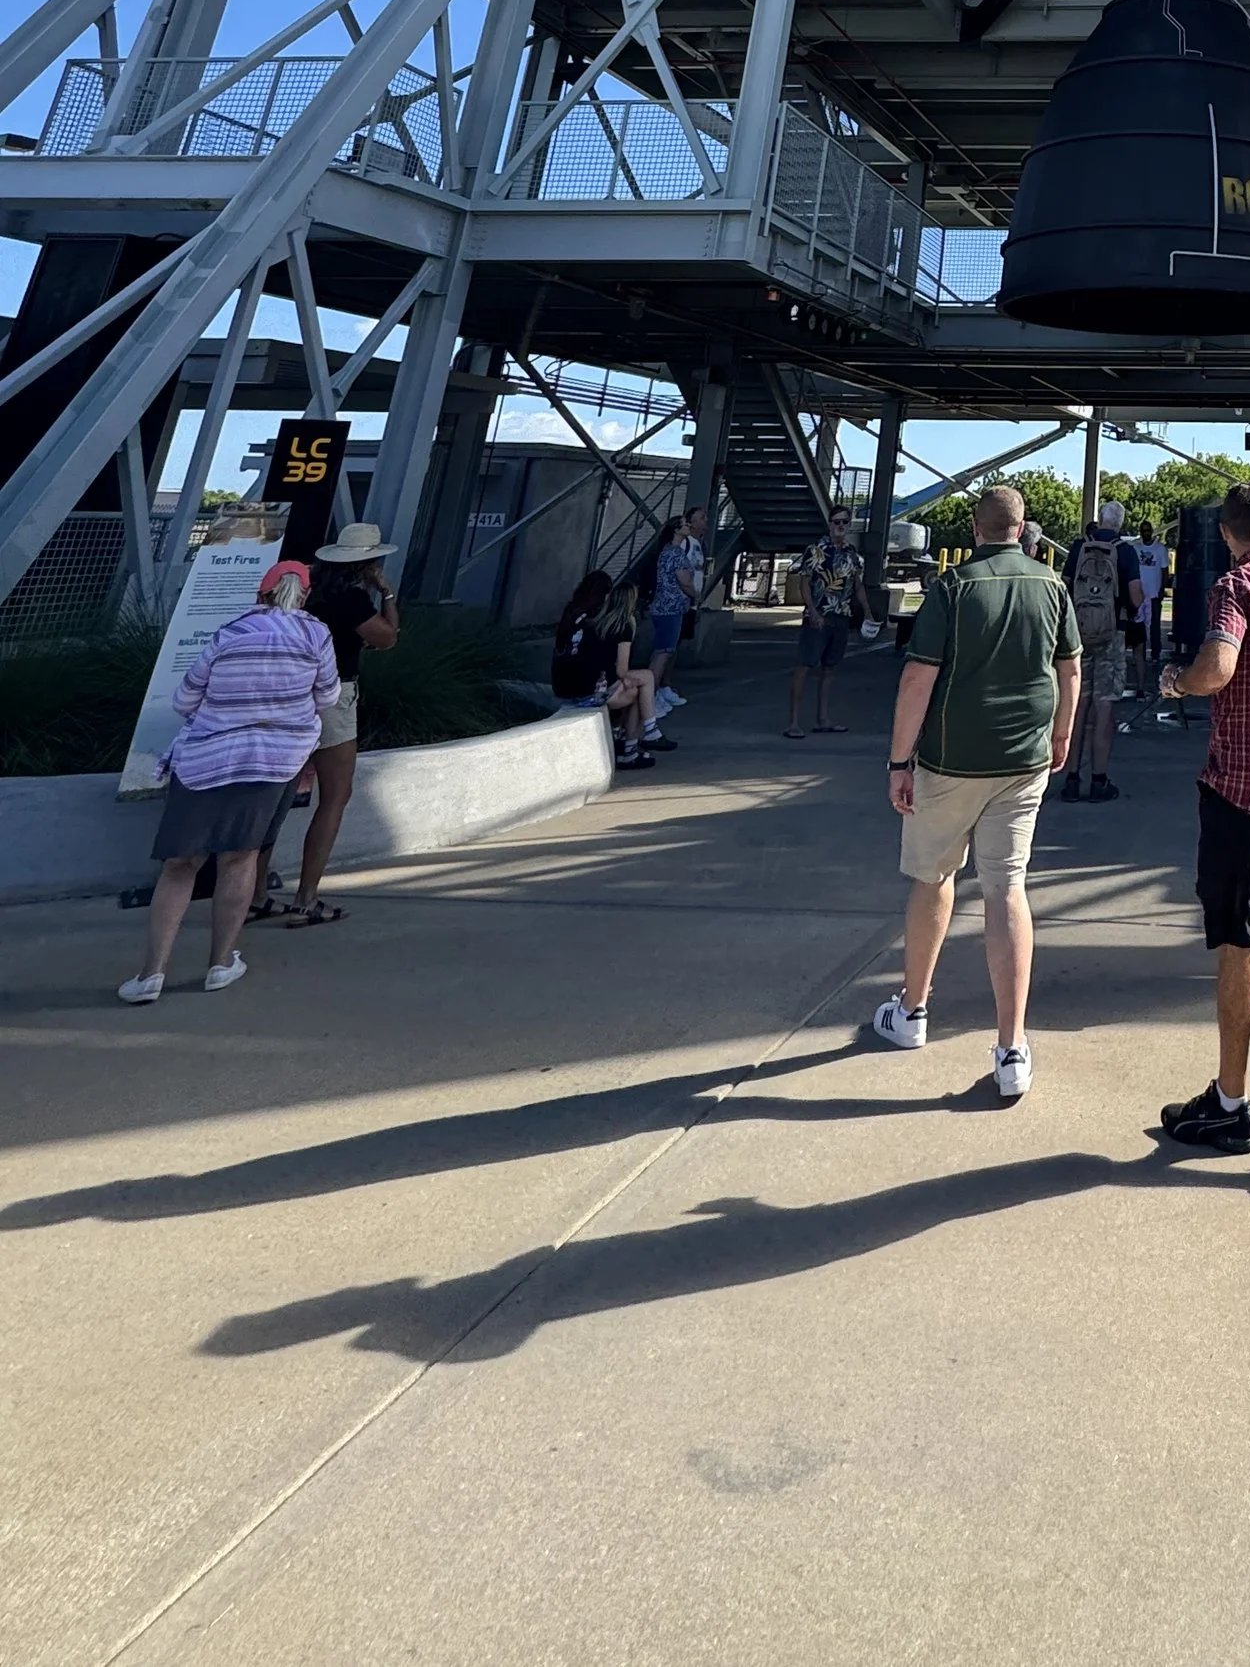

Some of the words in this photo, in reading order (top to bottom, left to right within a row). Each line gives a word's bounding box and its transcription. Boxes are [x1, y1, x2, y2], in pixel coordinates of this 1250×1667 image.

[290, 437, 332, 459] LC
[282, 461, 328, 483] 39
[211, 555, 232, 565] Test
[234, 554, 261, 565] Fires
